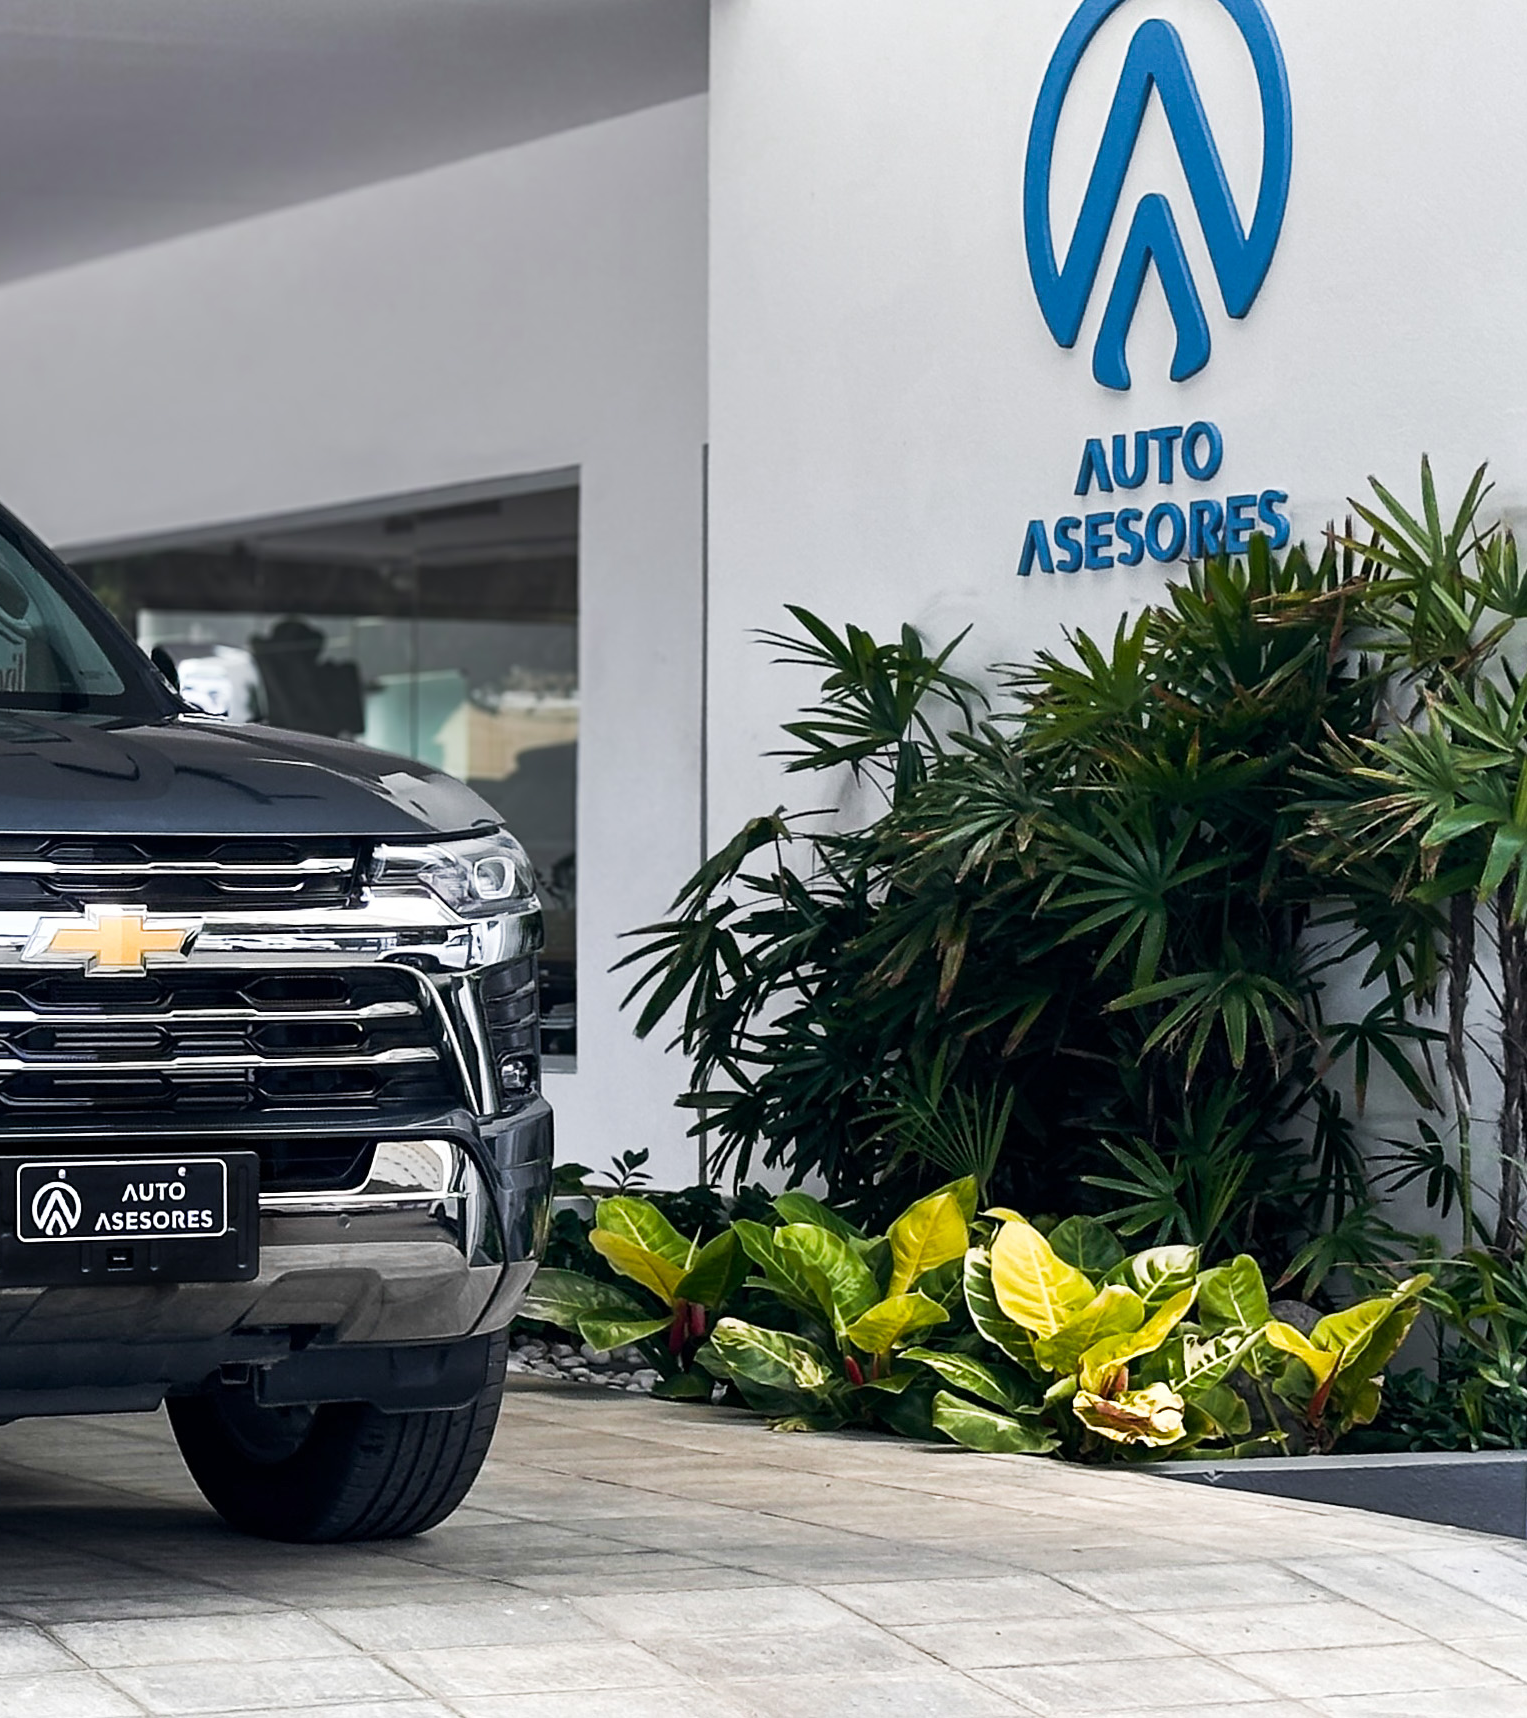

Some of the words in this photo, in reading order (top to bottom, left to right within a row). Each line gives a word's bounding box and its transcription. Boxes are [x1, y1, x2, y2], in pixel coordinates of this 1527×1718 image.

[1074, 420, 1223, 495] AUTO
[1017, 489, 1290, 577] ASESORES
[122, 1182, 186, 1202] AUTO
[94, 1210, 213, 1232] ASESORES
